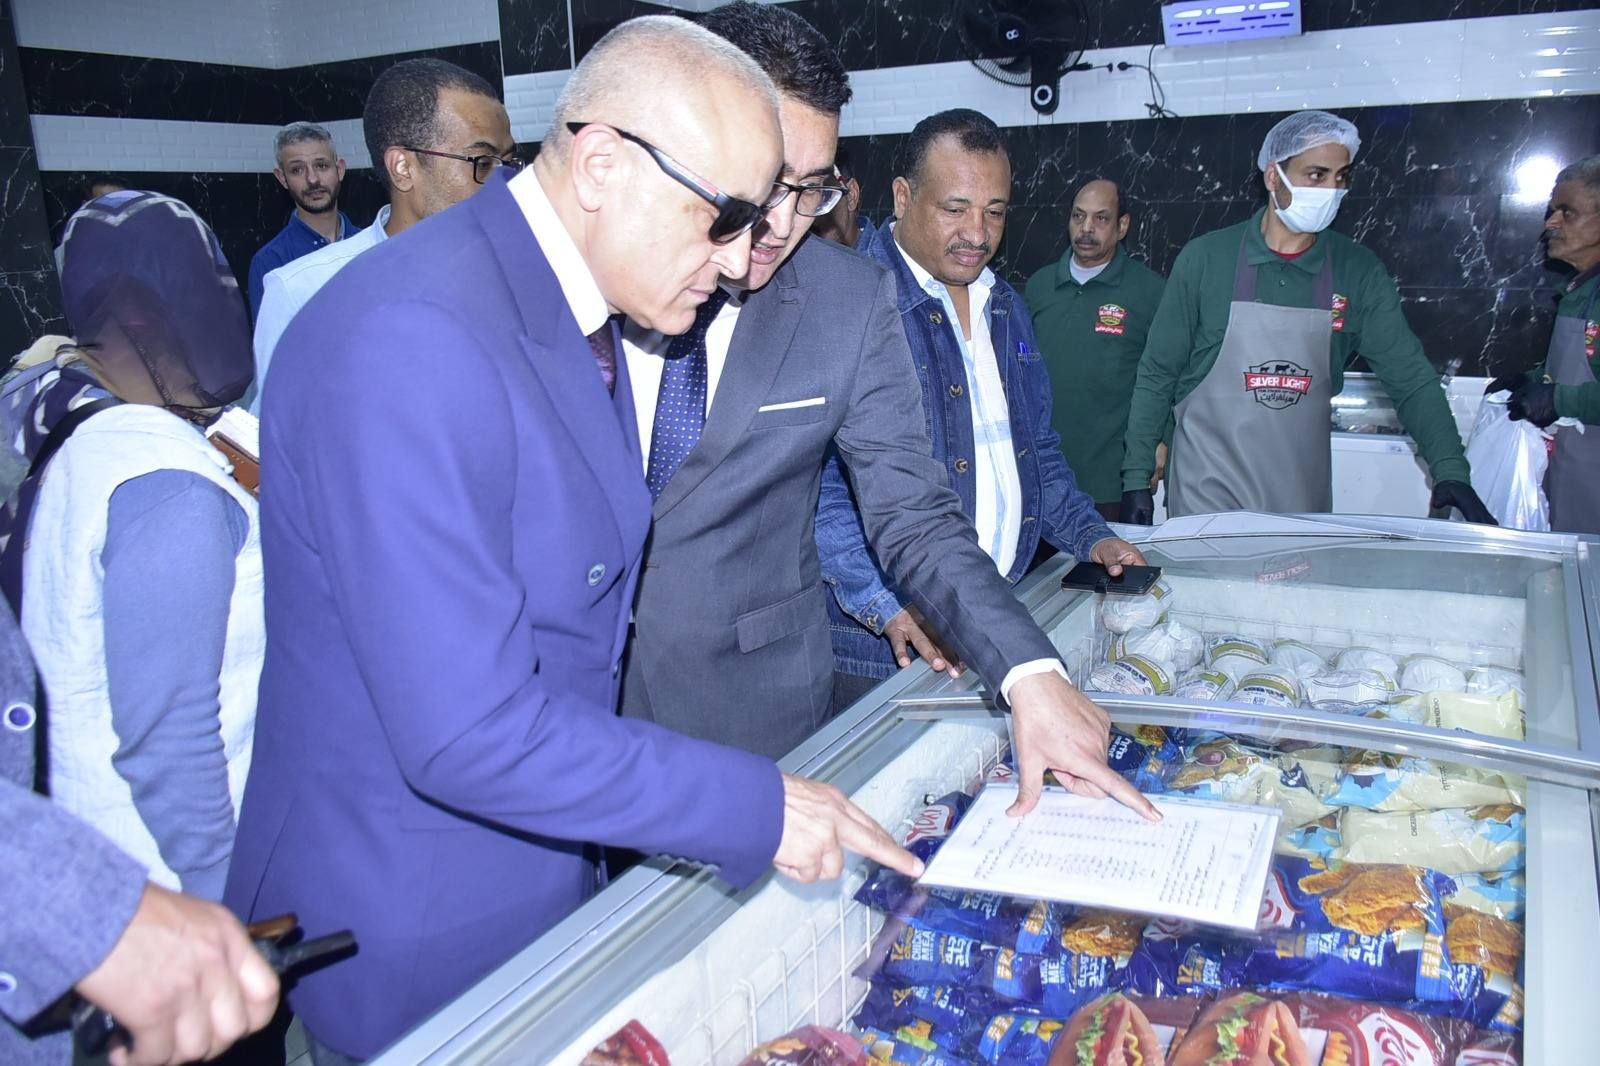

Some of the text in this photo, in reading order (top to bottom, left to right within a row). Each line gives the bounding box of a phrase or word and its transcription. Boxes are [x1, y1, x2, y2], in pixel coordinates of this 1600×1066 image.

[1249, 376, 1307, 391] SILVER LIGHT
[921, 931, 932, 961] MEA
[1048, 961, 1060, 984] ME
